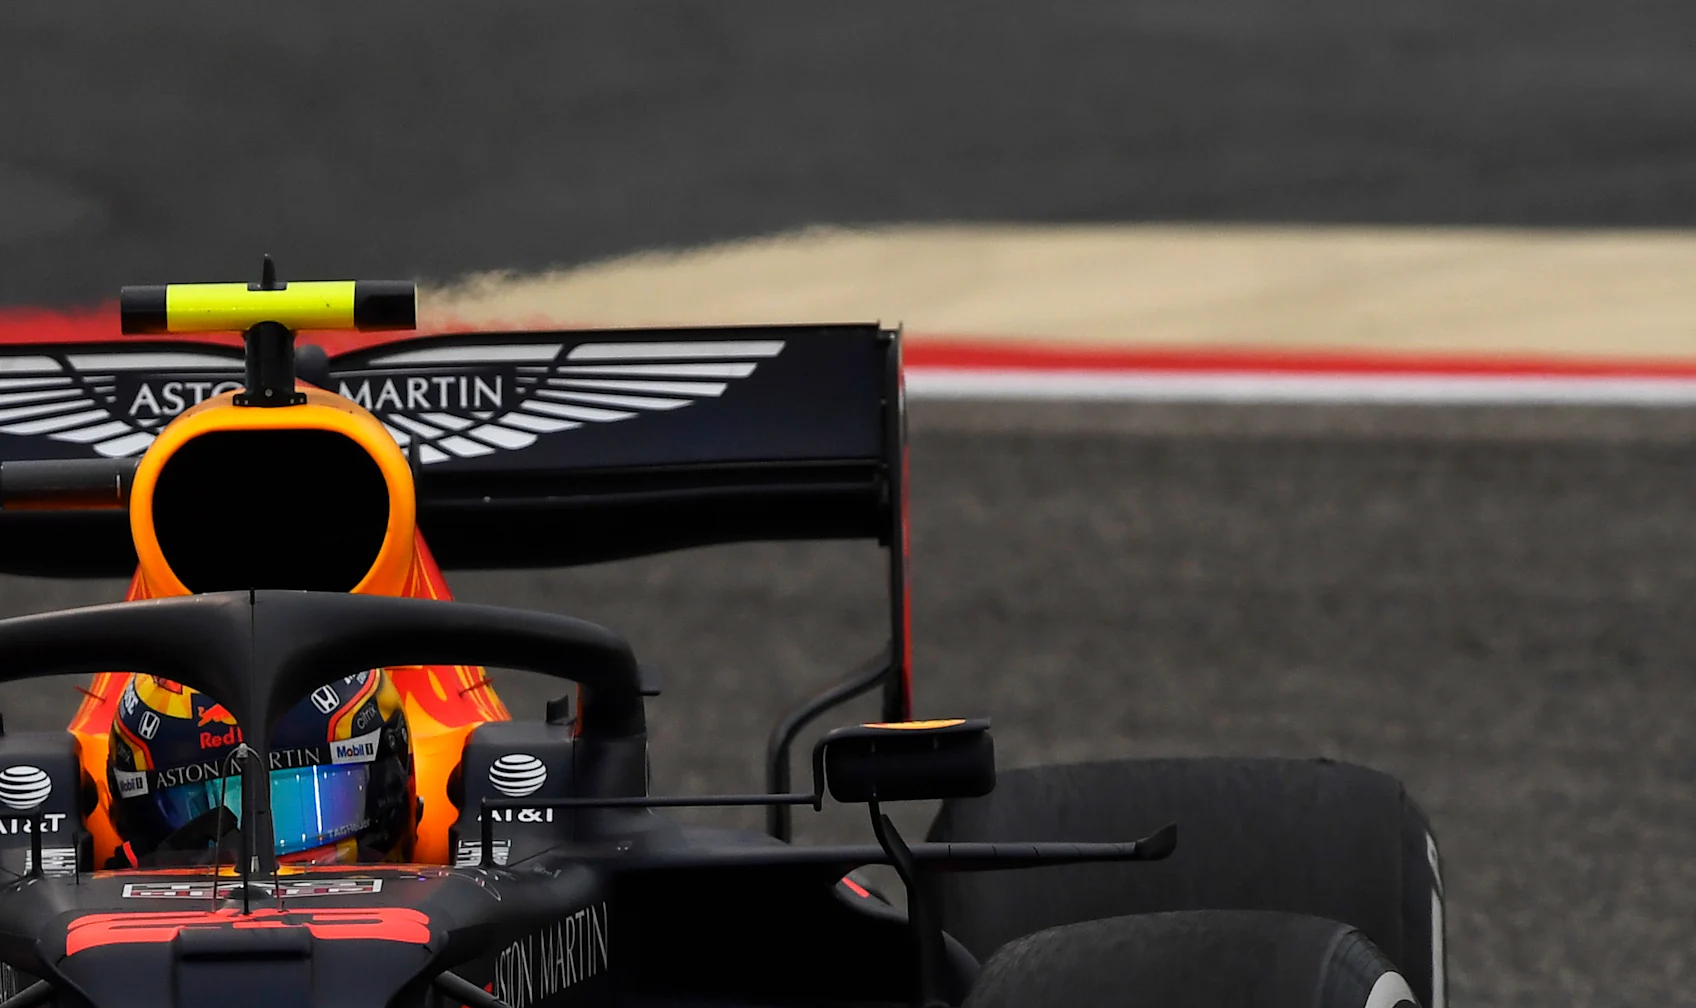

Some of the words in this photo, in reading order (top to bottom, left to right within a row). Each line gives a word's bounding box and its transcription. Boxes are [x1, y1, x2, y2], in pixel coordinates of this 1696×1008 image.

[128, 380, 246, 417] AST
[338, 374, 503, 411] MARTIN
[199, 726, 235, 750] Red
[336, 743, 365, 758] Mobil
[156, 759, 220, 790] ASTON
[230, 747, 321, 776] MRTIN
[540, 900, 608, 1000] MARTIN
